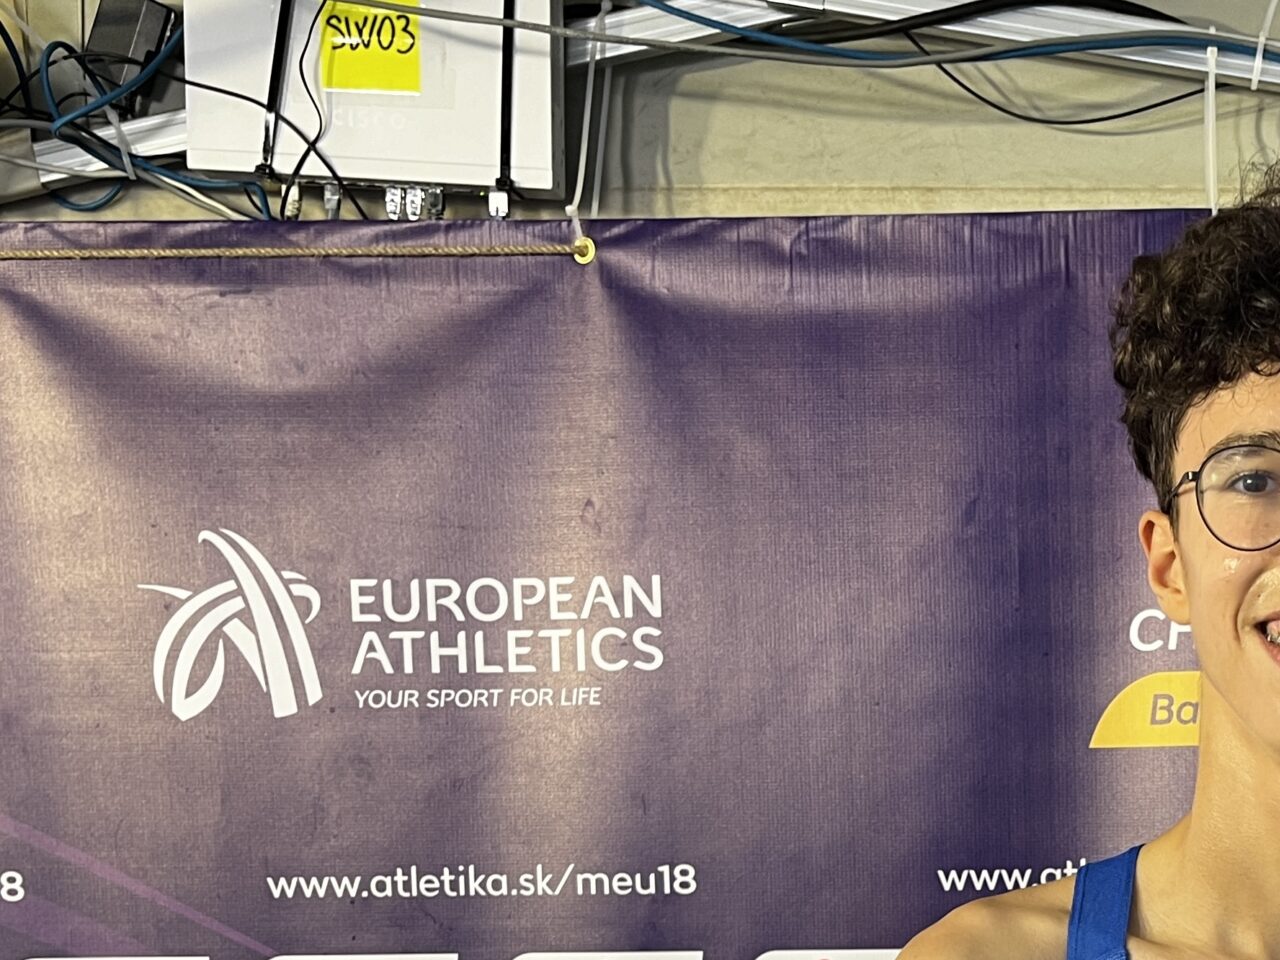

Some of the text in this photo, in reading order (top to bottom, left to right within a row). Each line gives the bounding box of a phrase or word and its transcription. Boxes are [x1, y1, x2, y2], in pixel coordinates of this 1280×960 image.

[349, 572, 664, 625] EUROPEAN
[350, 626, 666, 677] ATHLETICS
[353, 685, 604, 711] YOUR SPORT FOR LIFE
[265, 863, 699, 902] www.atletika.sk/meu18
